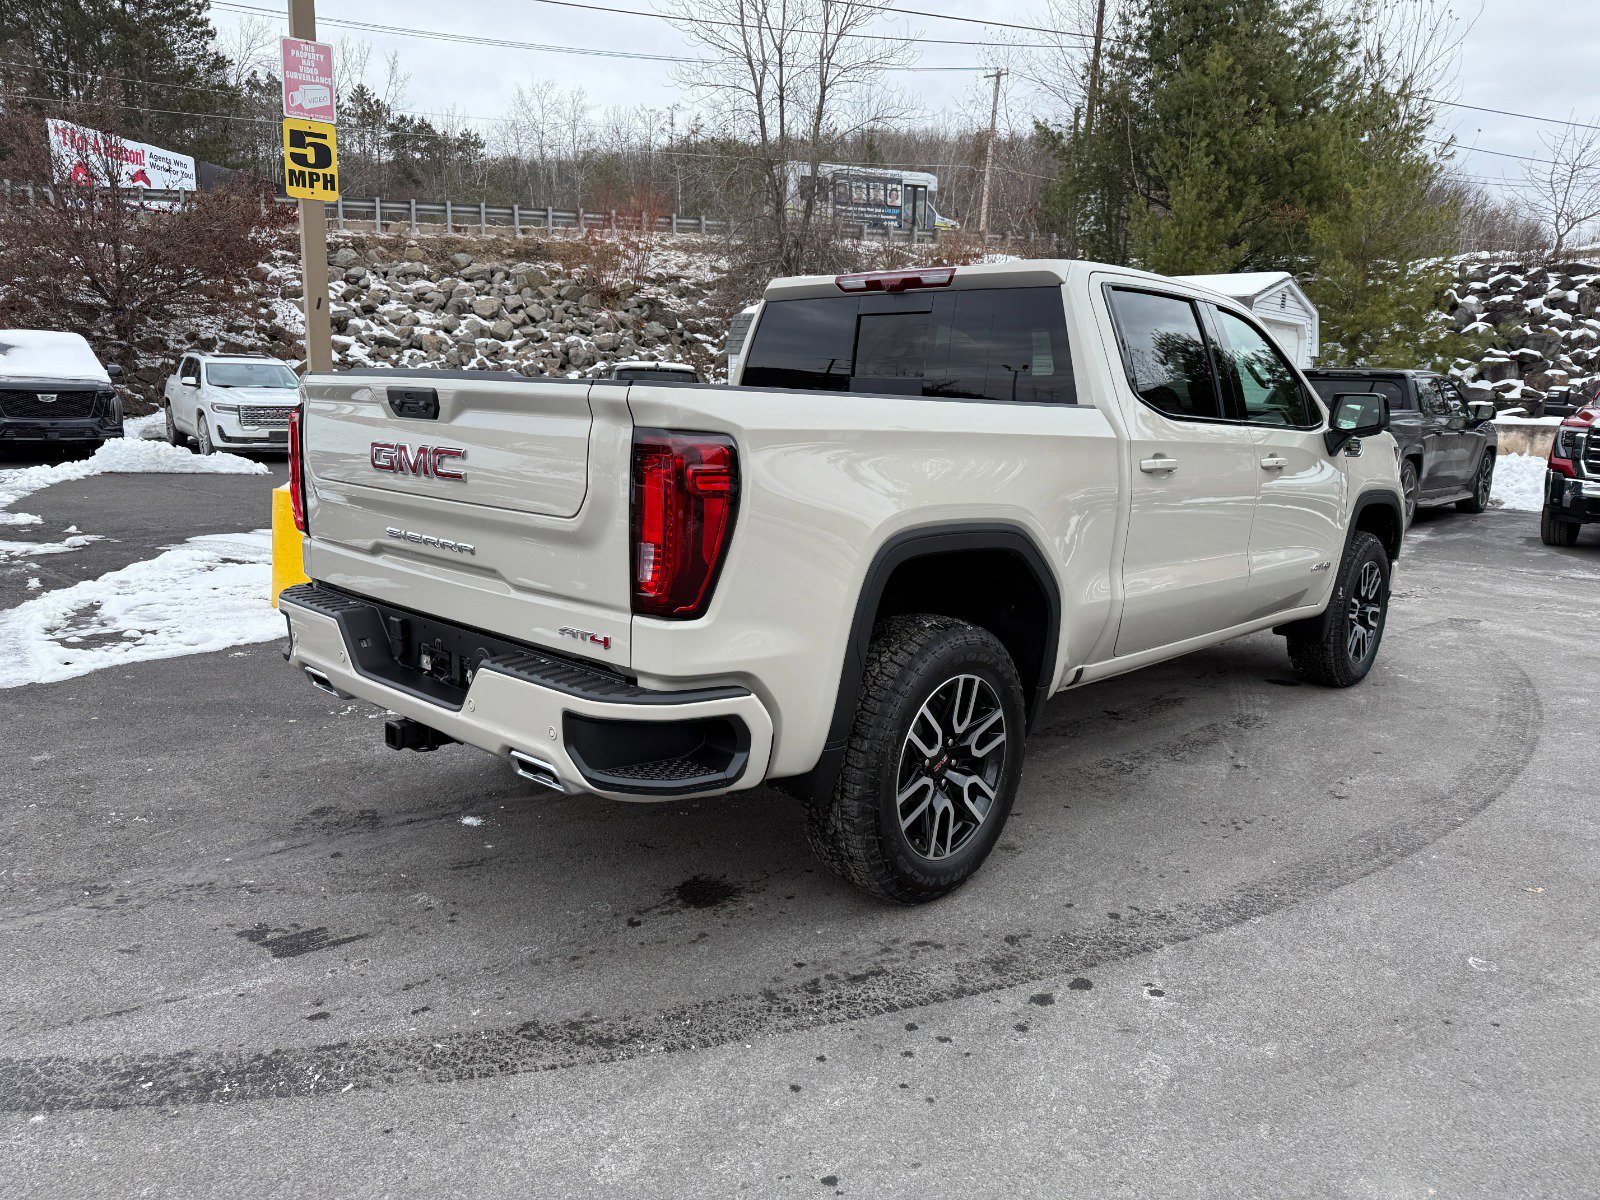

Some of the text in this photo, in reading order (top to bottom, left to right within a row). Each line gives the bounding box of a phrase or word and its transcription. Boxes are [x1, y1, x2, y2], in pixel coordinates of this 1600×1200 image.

[291, 49, 325, 61] PROPERTY
[300, 44, 315, 52] THIS
[299, 65, 319, 75] VIDEO
[302, 59, 315, 67] HAS
[285, 71, 332, 85] SURVEILLANCE
[308, 95, 328, 104] VIDEO
[289, 128, 332, 170] 5
[149, 152, 188, 169] Agents Who
[149, 161, 167, 171] Work
[180, 170, 194, 180] You!
[288, 169, 336, 192] MPH
[370, 441, 468, 483] GMC
[386, 526, 476, 556] SIERRA
[558, 625, 612, 650] AT4
